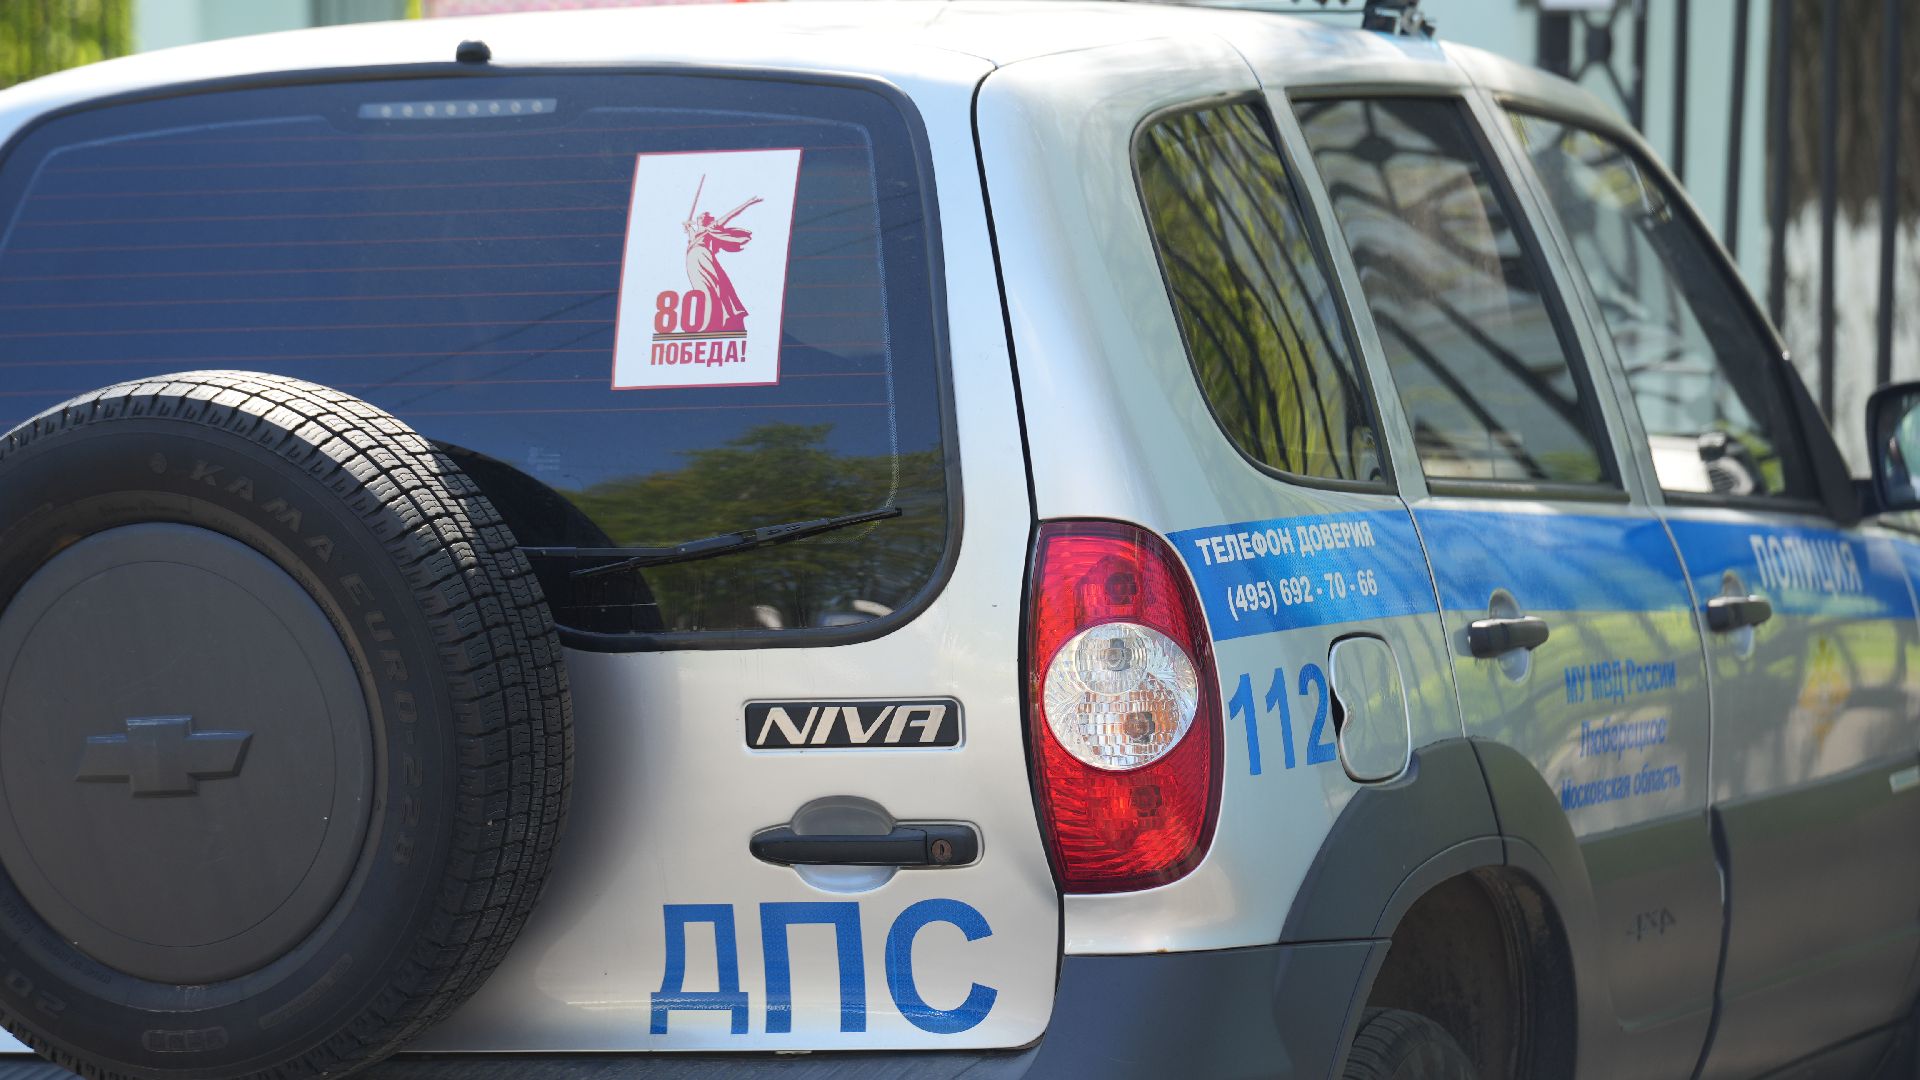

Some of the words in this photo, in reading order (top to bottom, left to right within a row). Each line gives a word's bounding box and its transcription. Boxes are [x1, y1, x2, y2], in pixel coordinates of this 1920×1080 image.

[654, 289, 706, 333] 80
[650, 340, 747, 367] ПОБЕДА!
[1195, 527, 1295, 566] ТЕЛЕФОН
[1296, 520, 1376, 558] ДОВЕРИЯ
[1749, 534, 1863, 598] ПОЛИЦИЯ
[1227, 580, 1278, 622] (495)
[1564, 664, 1587, 705] МУ
[1589, 659, 1625, 704] МВД
[1625, 658, 1677, 694] России
[756, 705, 947, 746] NIVA
[1228, 663, 1337, 776] 112
[1579, 716, 1668, 761] Люберецкое
[1561, 773, 1631, 812] Московская
[1633, 761, 1681, 796] область
[650, 898, 998, 1035] ДПС
